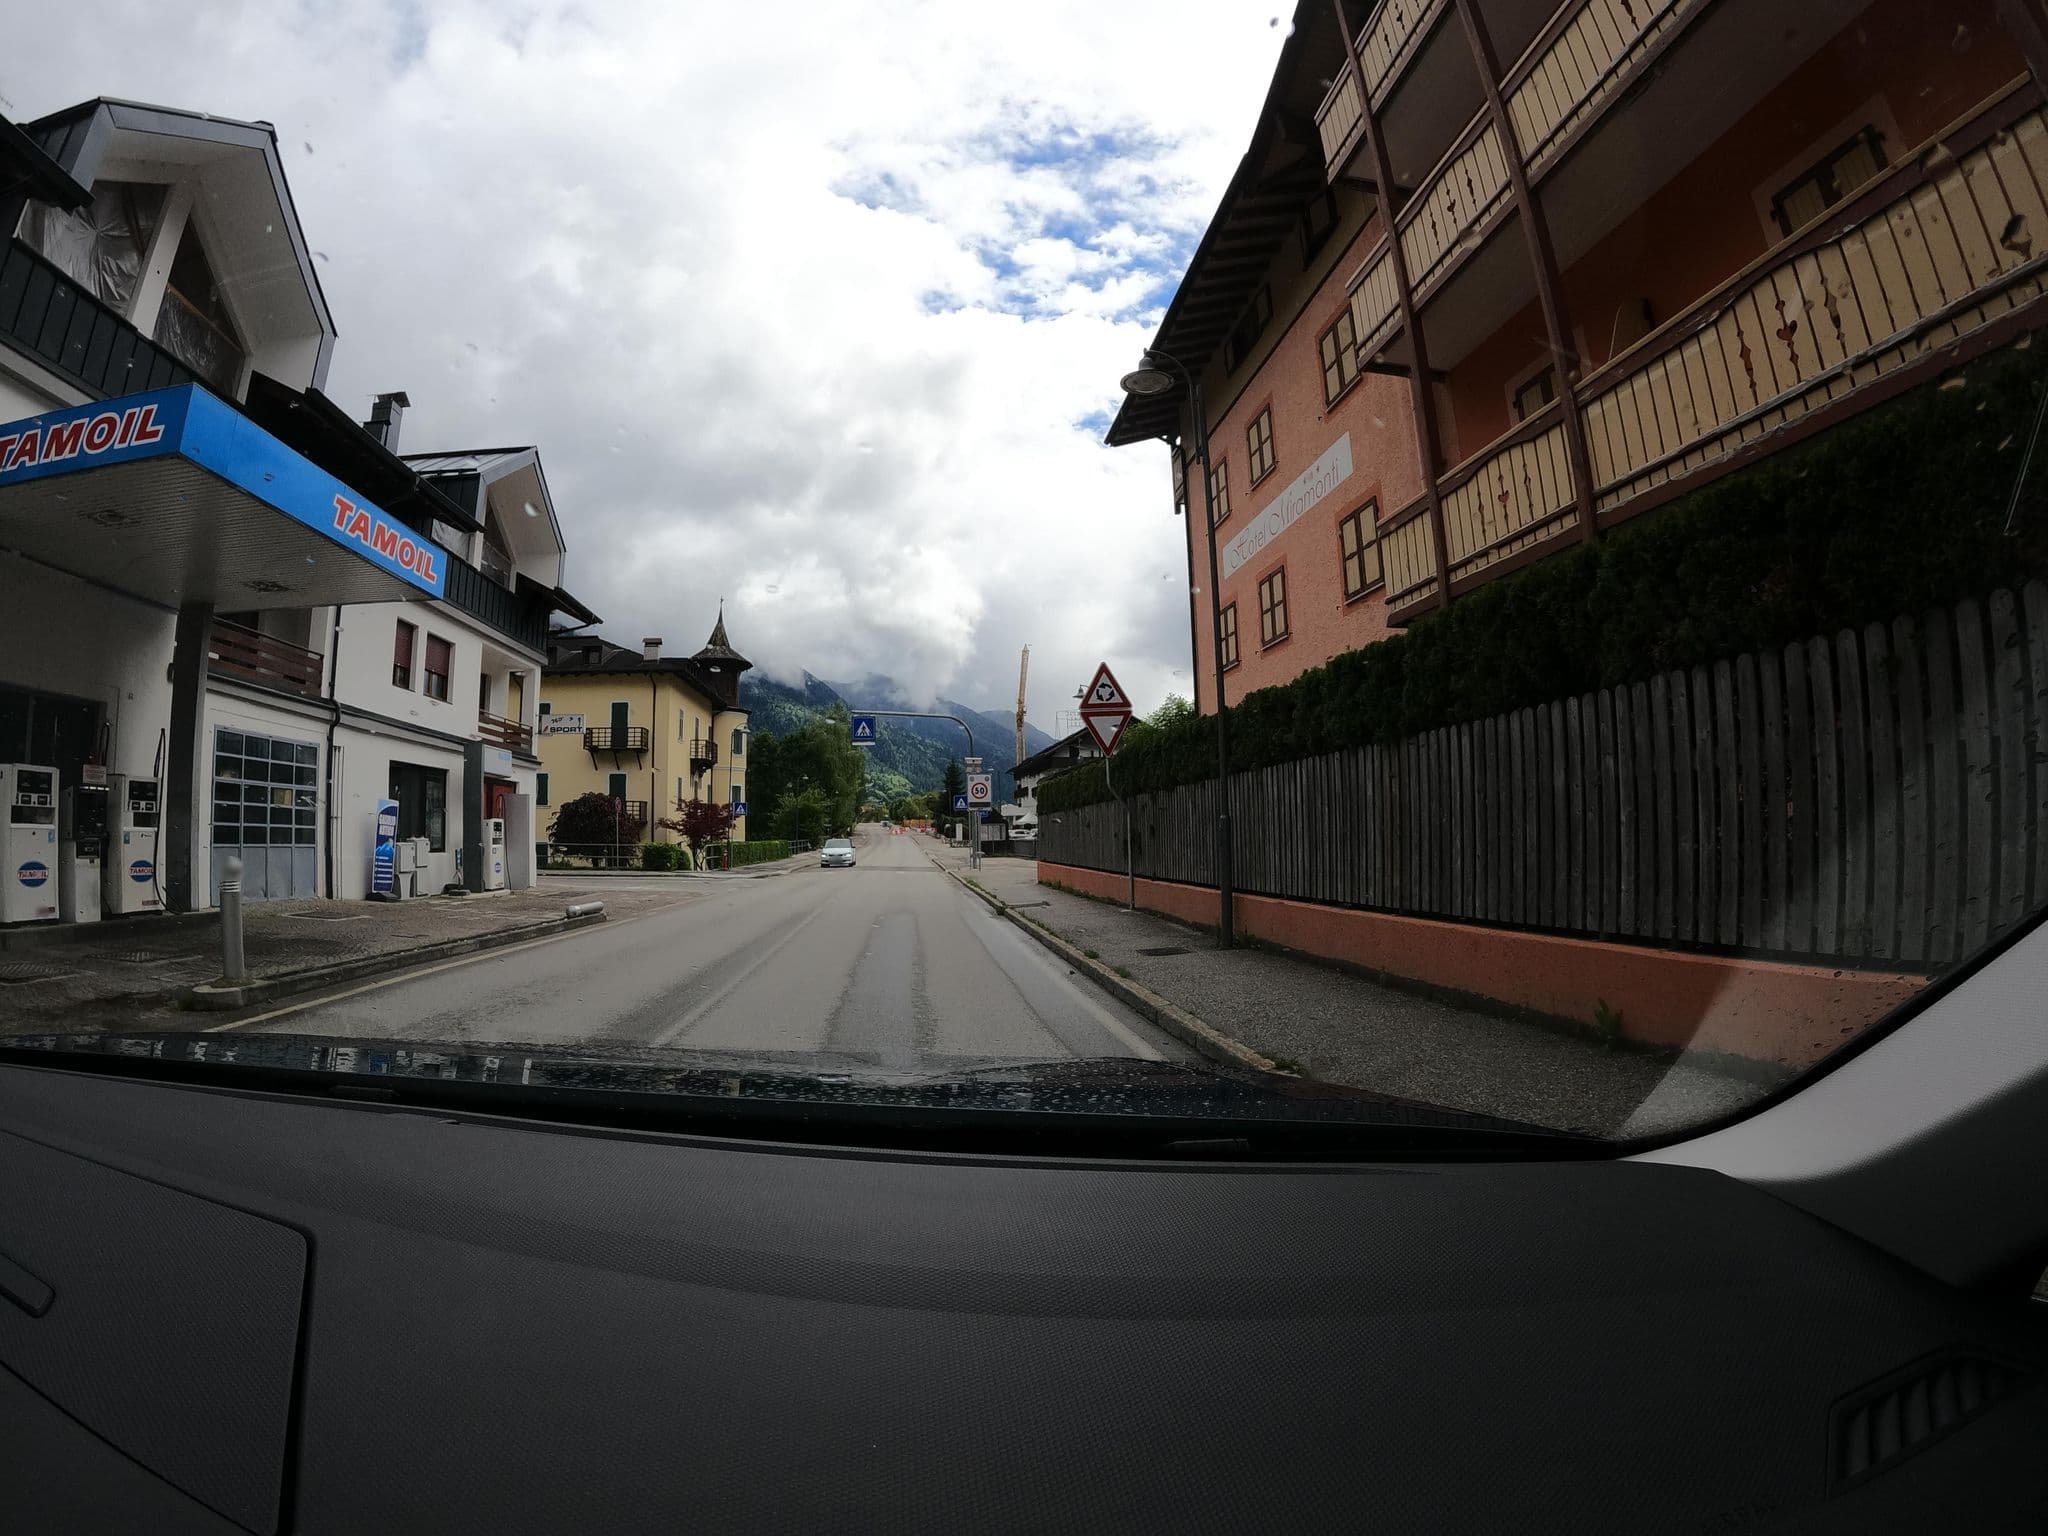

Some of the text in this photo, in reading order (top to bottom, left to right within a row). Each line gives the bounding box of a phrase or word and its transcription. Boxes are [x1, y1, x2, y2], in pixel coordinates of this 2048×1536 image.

[333, 493, 437, 584] TAMOIL
[1230, 458, 1340, 569] Hotel Miramonti
[974, 786, 985, 795] 50
